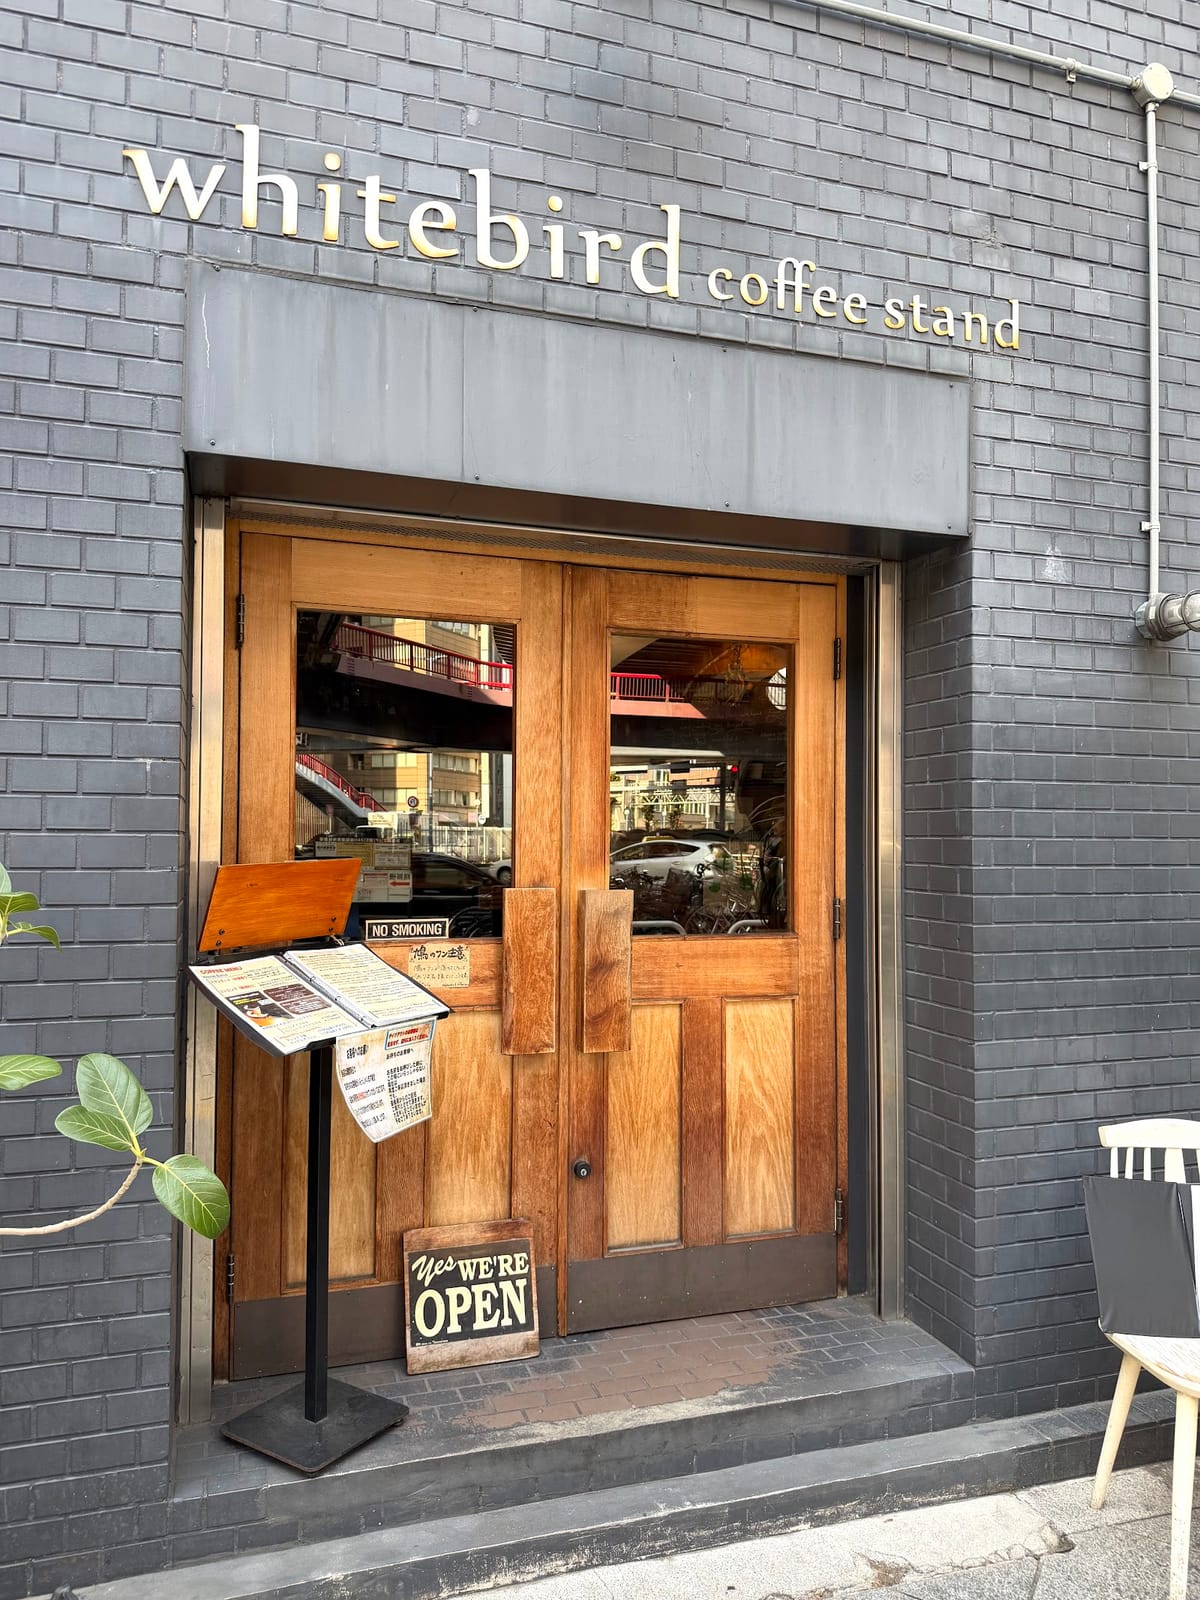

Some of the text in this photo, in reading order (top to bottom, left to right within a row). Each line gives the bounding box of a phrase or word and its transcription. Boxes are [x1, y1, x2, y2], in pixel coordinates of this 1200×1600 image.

[122, 124, 1020, 350] whitebird coffee stand
[372, 923, 443, 937] NO SMOKING
[412, 1253, 530, 1287] Yes WE'RE
[415, 1278, 528, 1338] OPEN
